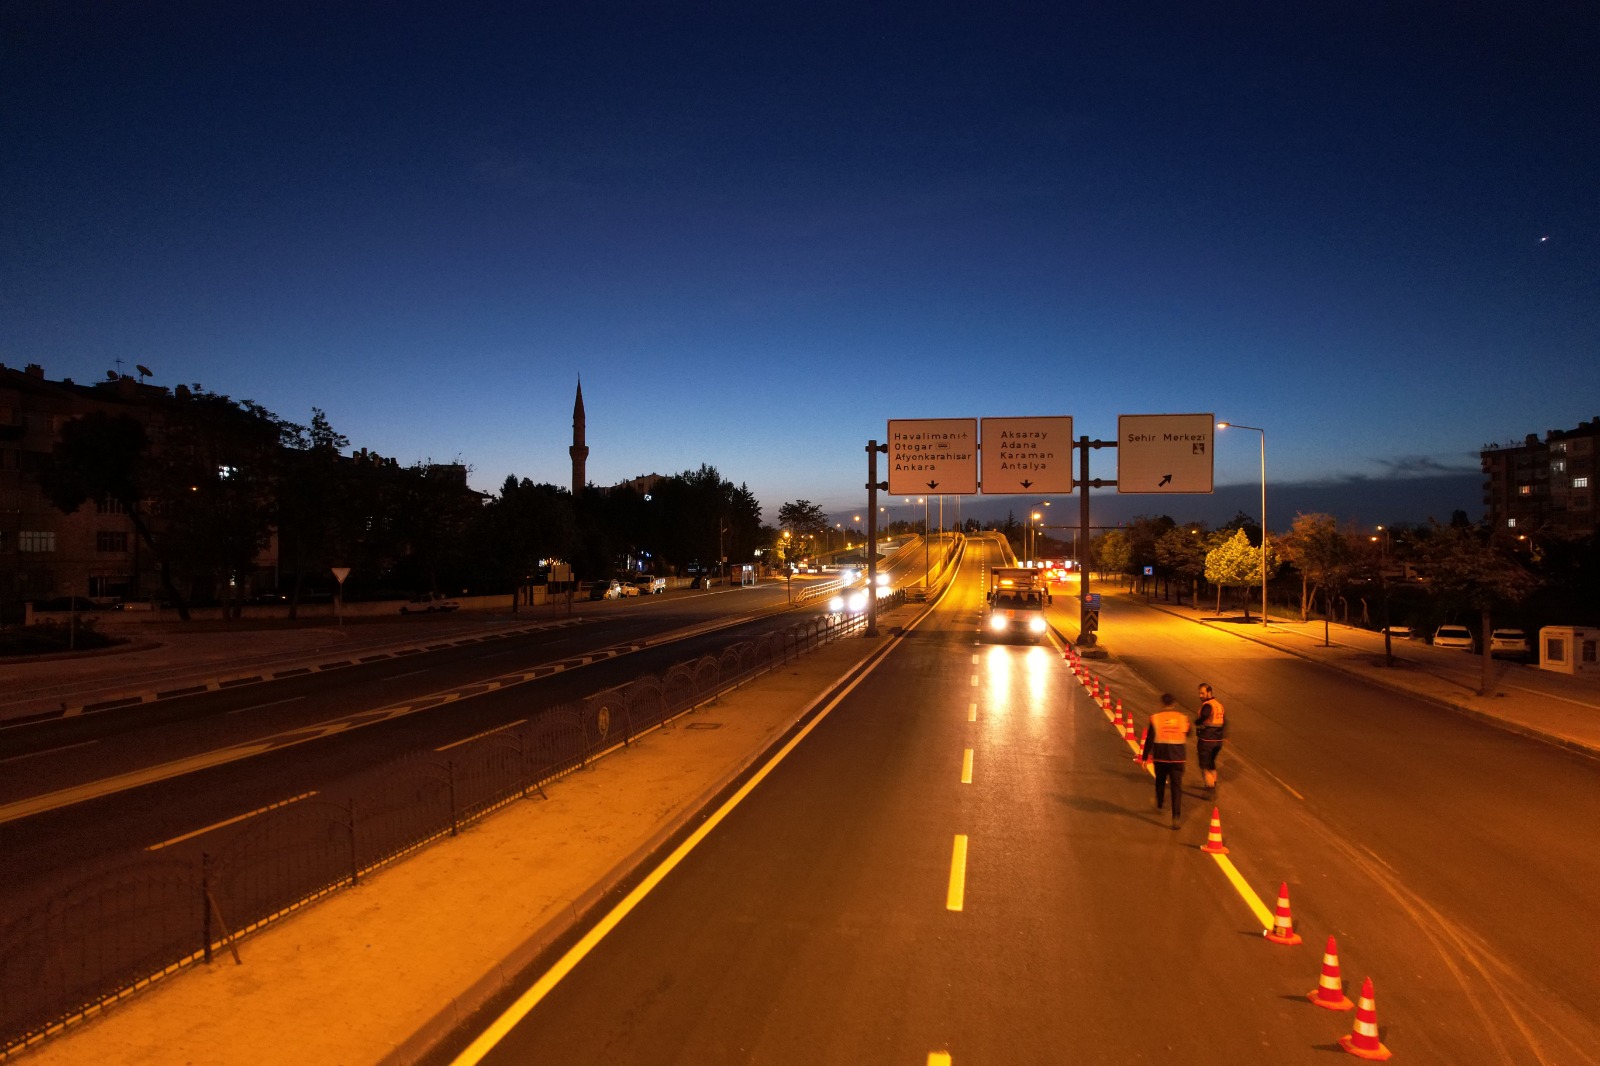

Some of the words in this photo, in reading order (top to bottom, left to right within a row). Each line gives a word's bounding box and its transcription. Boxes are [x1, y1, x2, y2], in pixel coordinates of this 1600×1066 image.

[1001, 431, 1048, 439] Aksaray
[1128, 433, 1156, 442] Şehir
[1163, 433, 1205, 441] Merkezi
[894, 443, 933, 452] Otogar
[1001, 441, 1037, 449] Adana
[895, 452, 972, 462] Afyonkarahisar
[1000, 451, 1054, 459] Karaman
[895, 463, 936, 471] Ankara
[1001, 462, 1047, 471] Antalya
